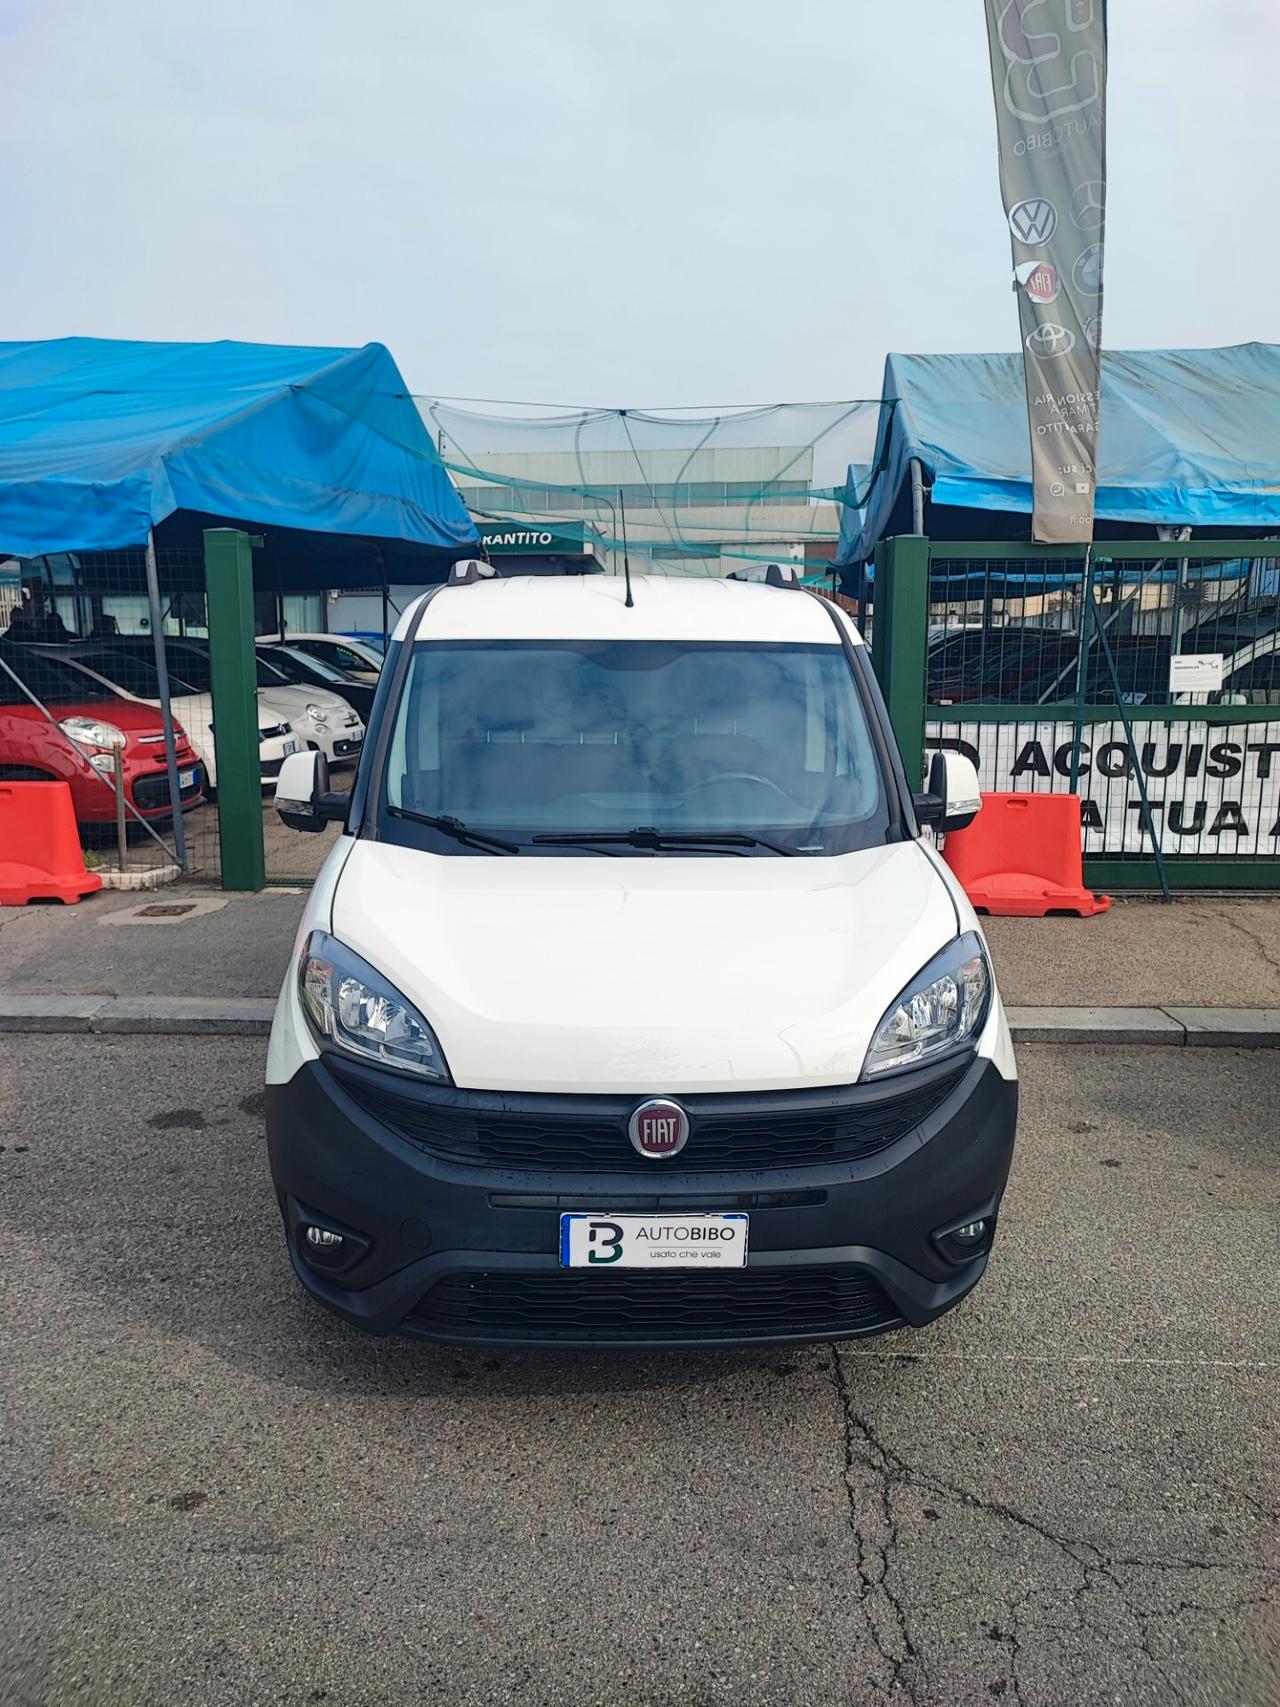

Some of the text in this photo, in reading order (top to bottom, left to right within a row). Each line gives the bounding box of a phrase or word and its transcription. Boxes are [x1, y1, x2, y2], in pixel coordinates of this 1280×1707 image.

[1080, 799, 1105, 834] A
[1127, 800, 1250, 836] TUA
[643, 1118, 676, 1144] FIAT
[635, 1226, 735, 1241] AUTOBIBO
[650, 1250, 722, 1259] usato che vale
